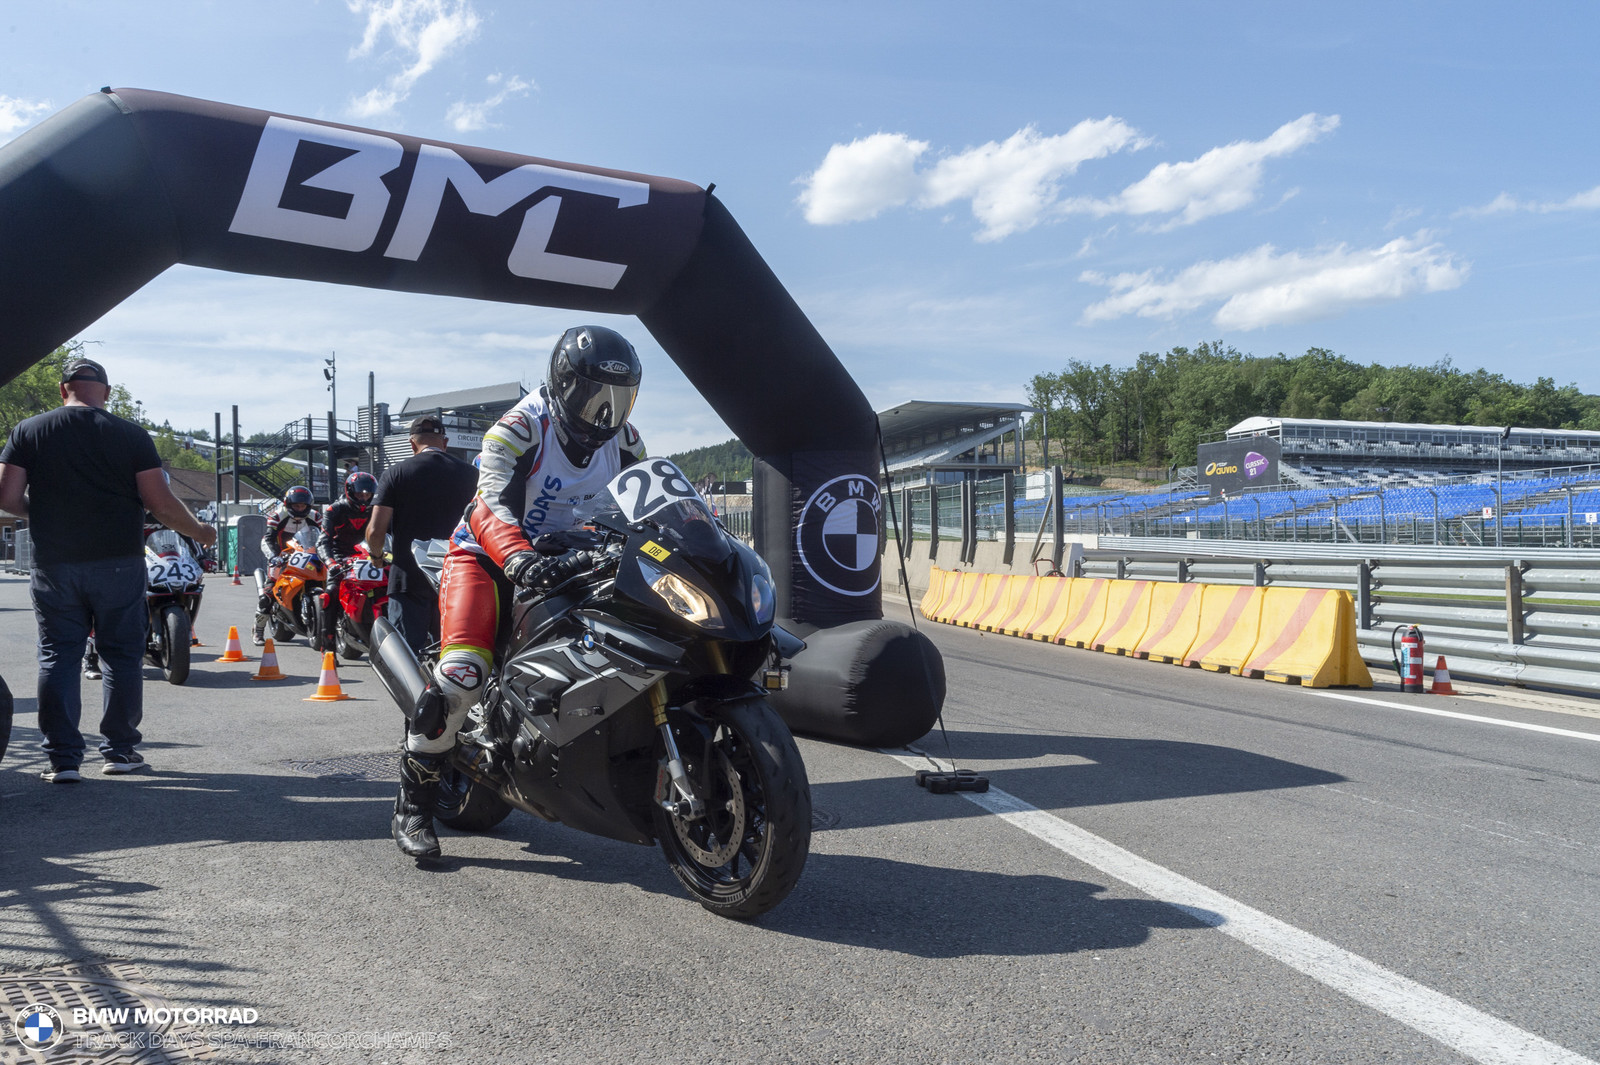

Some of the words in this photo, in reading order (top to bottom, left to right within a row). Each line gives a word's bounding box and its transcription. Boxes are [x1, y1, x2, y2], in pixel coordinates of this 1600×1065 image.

[228, 116, 649, 290] BMC
[457, 434, 479, 442] CIRCUIT
[1249, 468, 1257, 476] 21
[618, 461, 697, 520] 28
[815, 480, 880, 513] BMW
[523, 475, 562, 539] KDAYS
[289, 552, 313, 569] 61
[648, 546, 662, 557] DB
[150, 562, 196, 584] 243
[355, 561, 381, 580] 78
